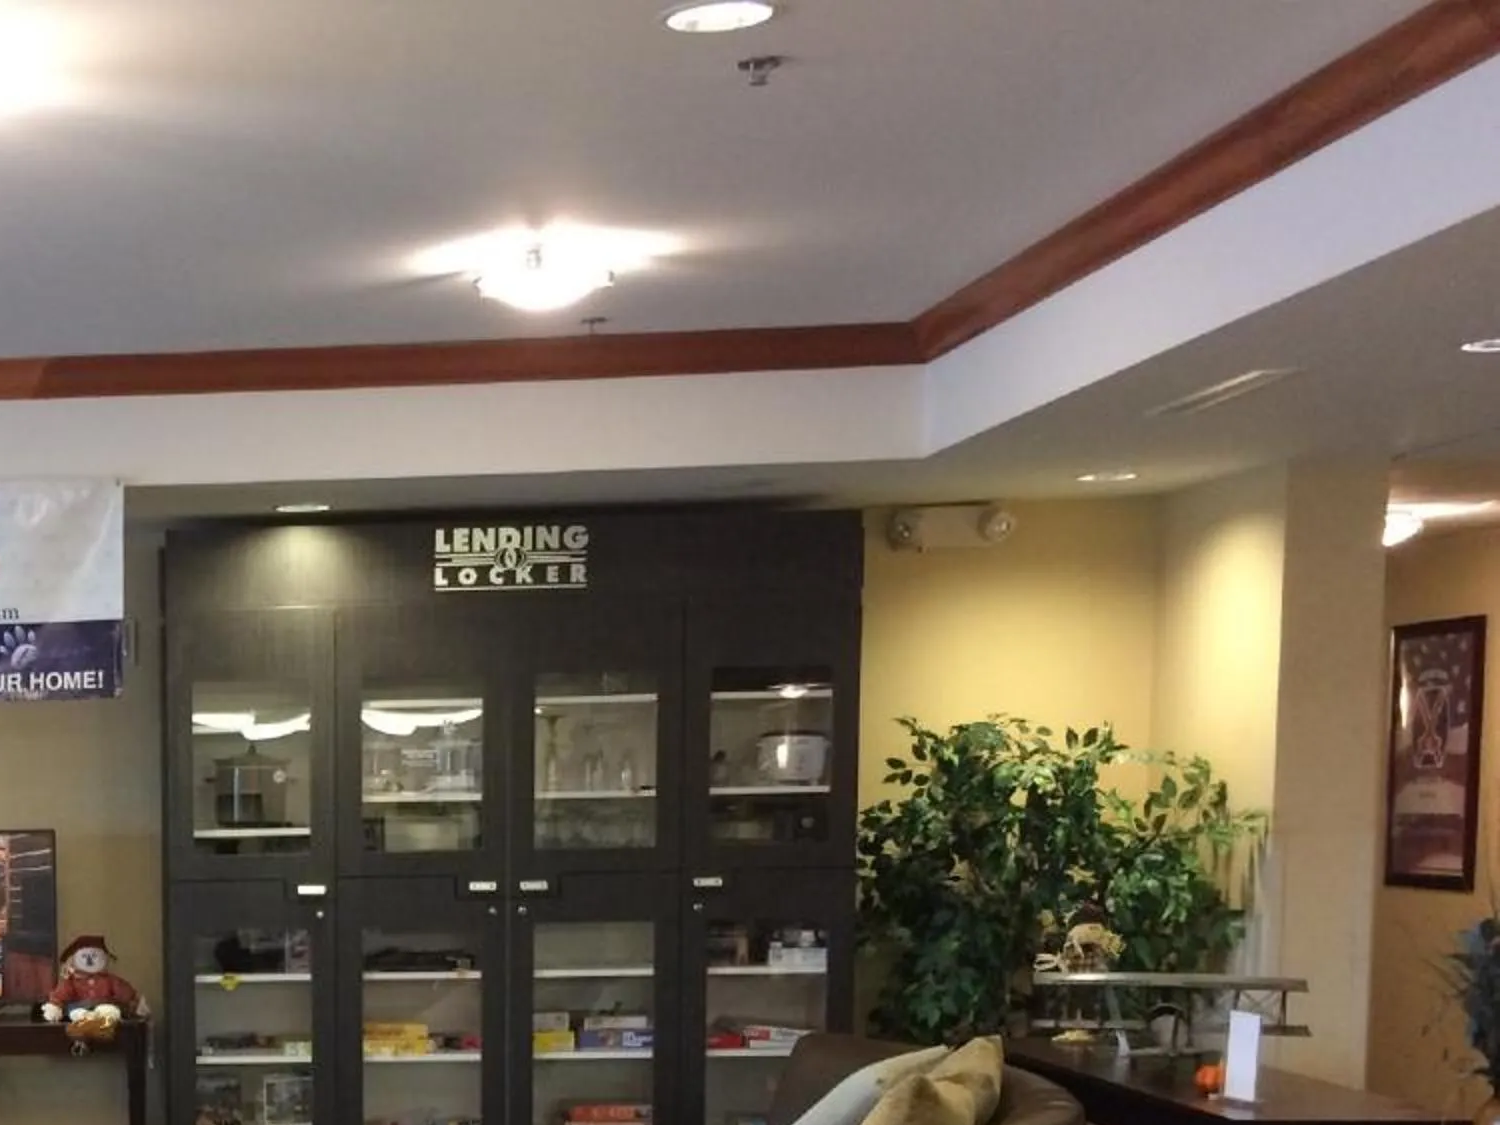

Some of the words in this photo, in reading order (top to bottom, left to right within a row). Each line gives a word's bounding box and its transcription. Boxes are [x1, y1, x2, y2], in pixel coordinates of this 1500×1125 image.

[435, 525, 590, 553] LENDING
[434, 563, 588, 586] LOCKER
[29, 669, 105, 691] HOME!
